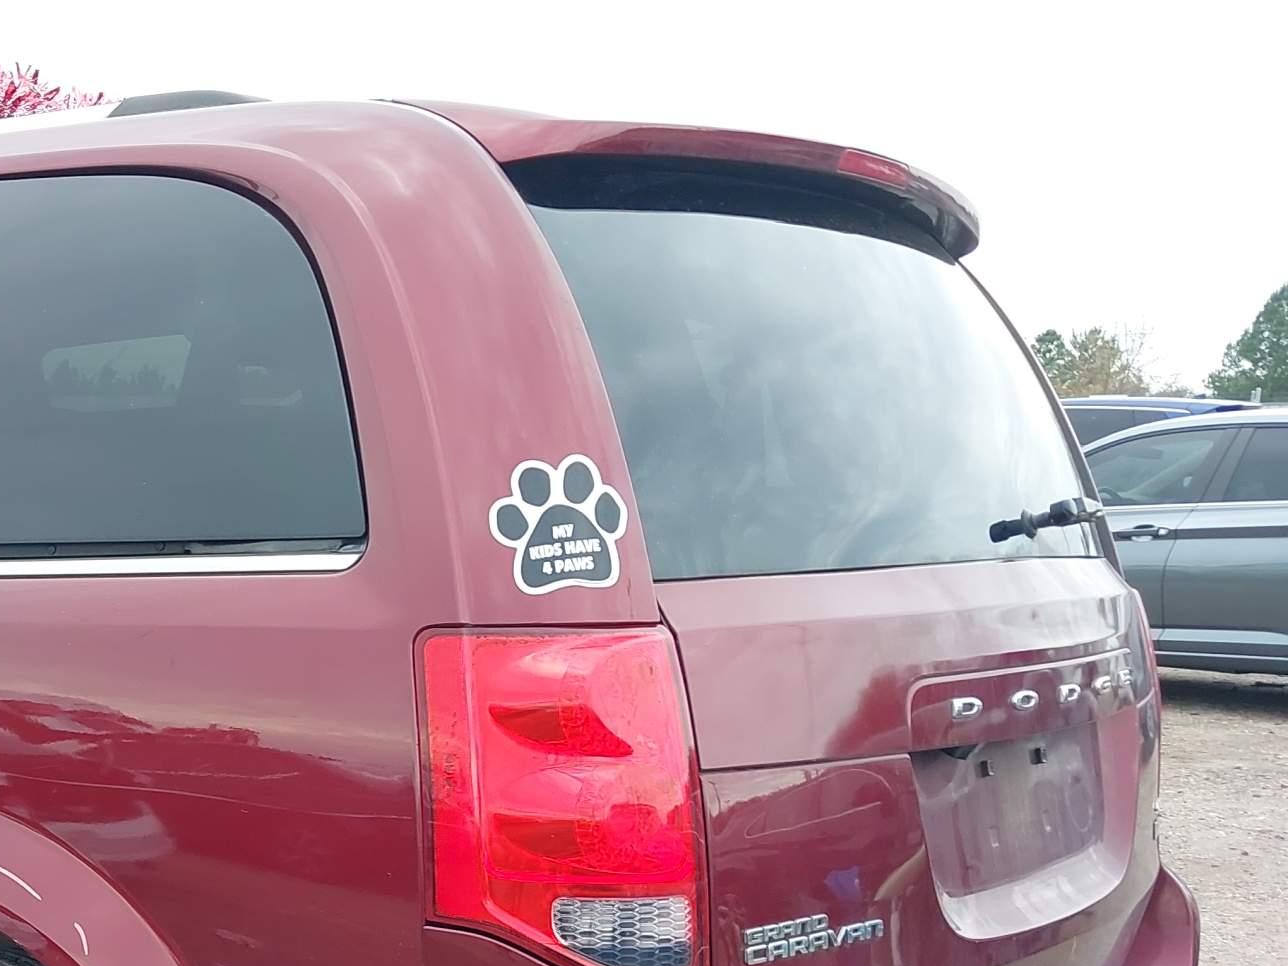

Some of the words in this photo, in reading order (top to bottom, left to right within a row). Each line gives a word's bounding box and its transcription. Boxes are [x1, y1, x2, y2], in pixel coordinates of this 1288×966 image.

[552, 523, 574, 539] MY
[529, 543, 563, 560] KIDS
[563, 538, 602, 555] HAVE
[542, 561, 553, 575] 4
[554, 556, 595, 574] PAWS
[951, 668, 1133, 720] DODGE
[744, 913, 830, 945] GRAND
[744, 919, 885, 966] CARAVAN
